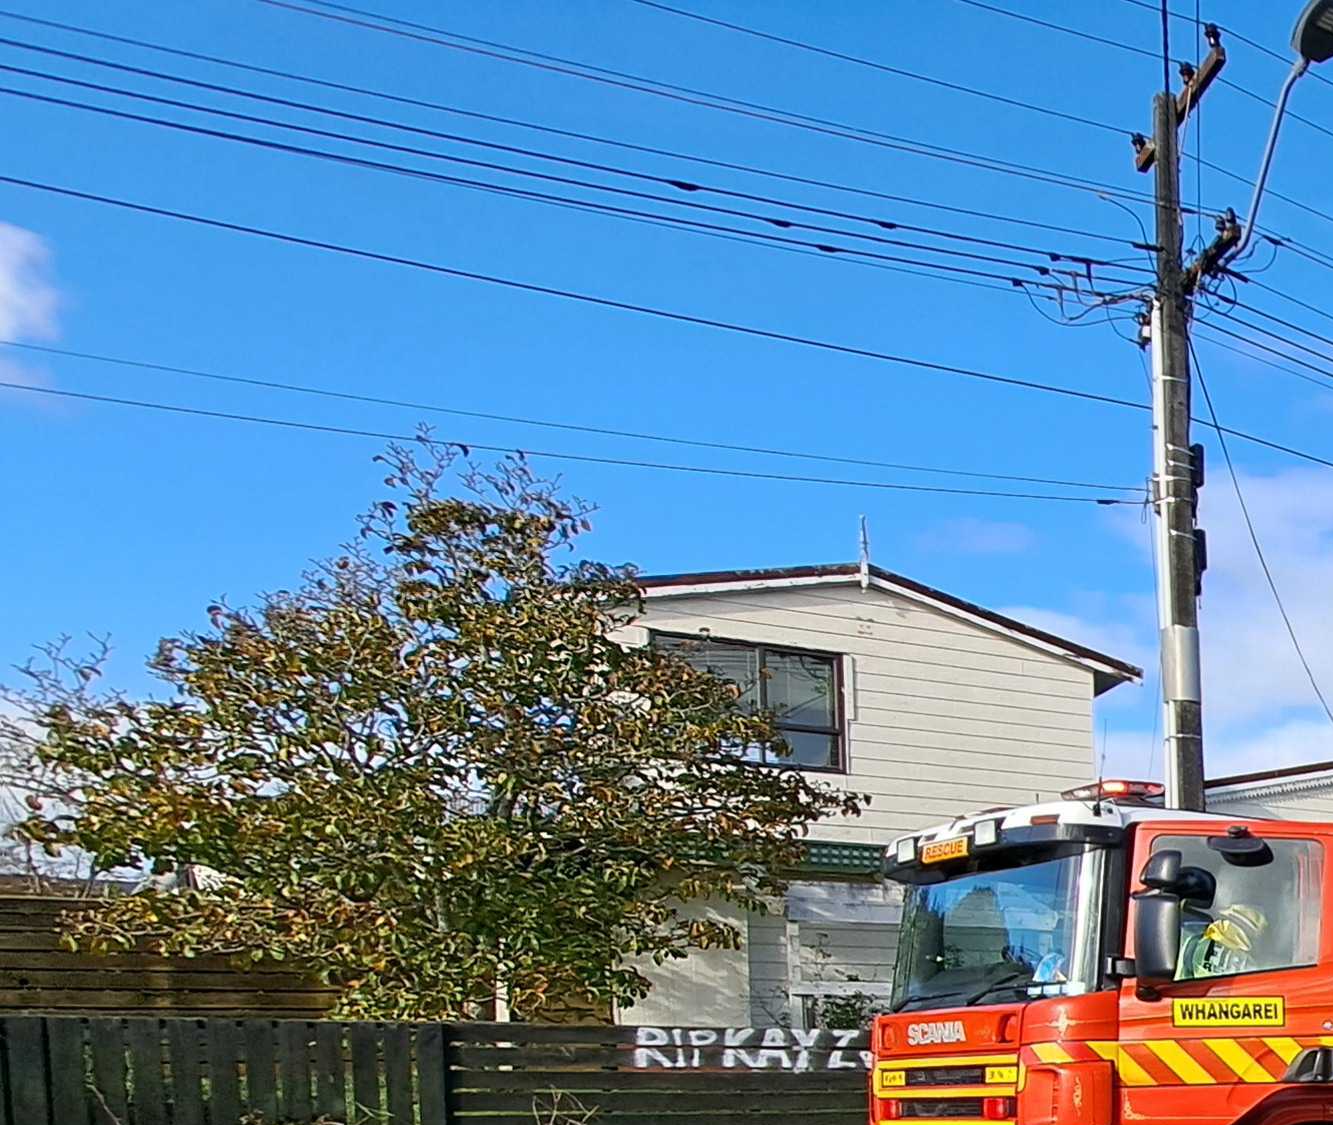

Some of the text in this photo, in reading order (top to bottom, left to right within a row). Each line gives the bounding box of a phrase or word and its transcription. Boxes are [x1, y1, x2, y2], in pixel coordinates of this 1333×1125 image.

[925, 839, 963, 860] RESCUE
[1180, 1003, 1278, 1020] WHANGAREI
[907, 1020, 967, 1046] SCANIA
[634, 1027, 717, 1069] RIP
